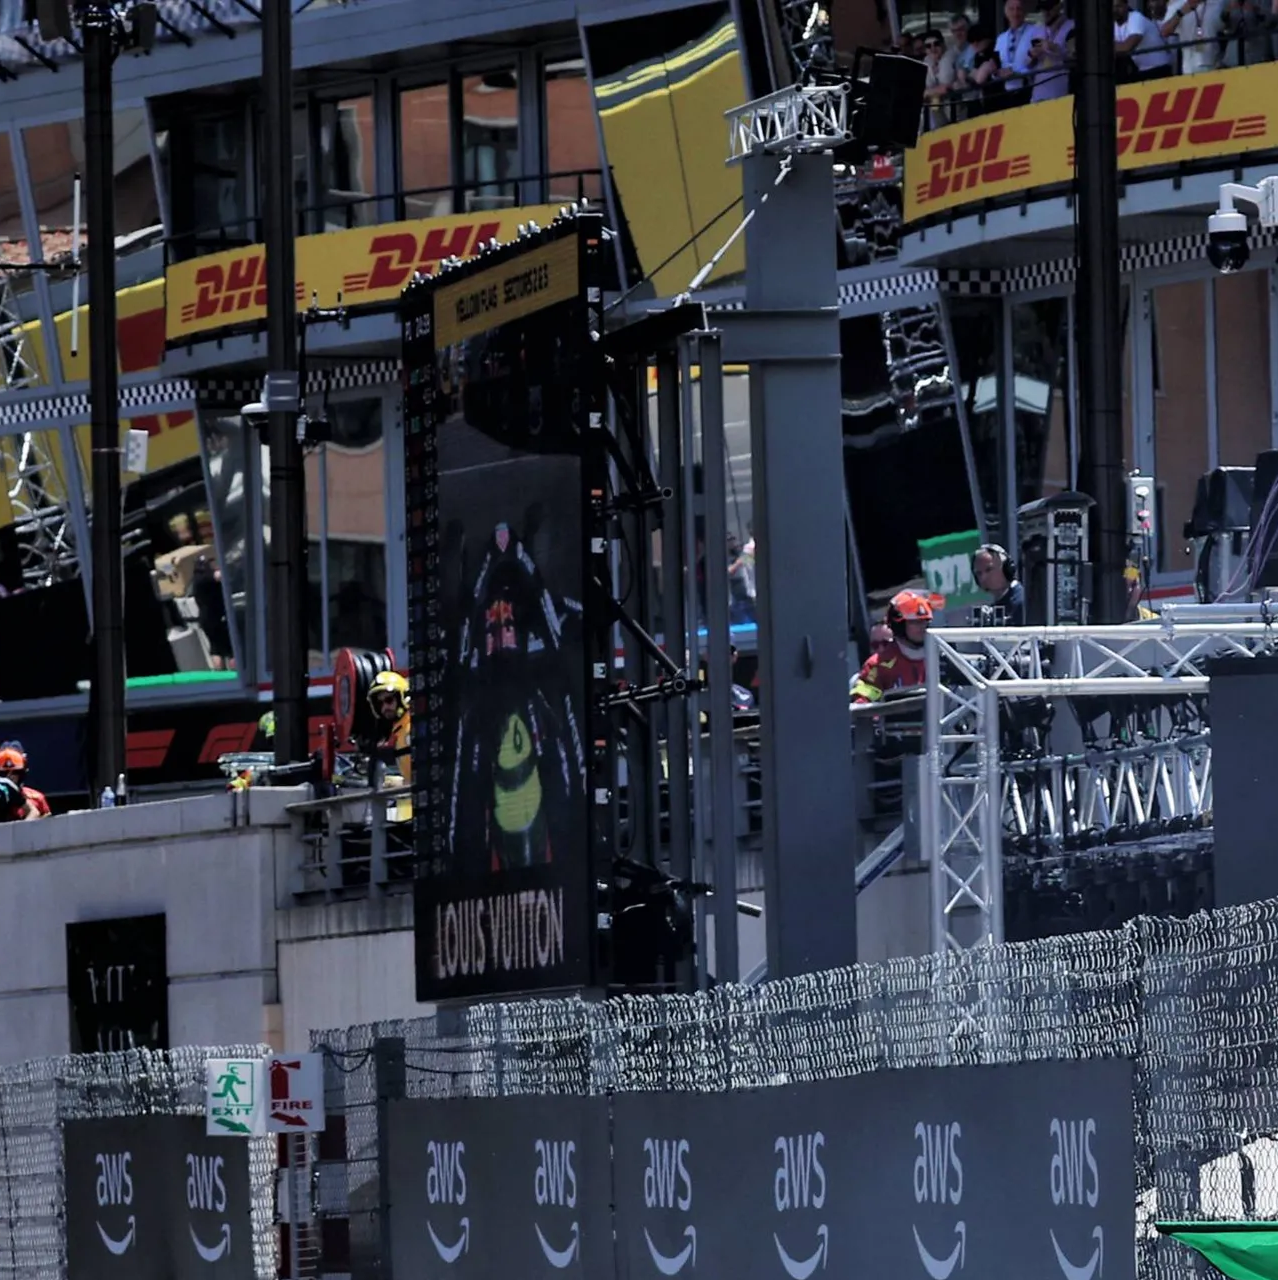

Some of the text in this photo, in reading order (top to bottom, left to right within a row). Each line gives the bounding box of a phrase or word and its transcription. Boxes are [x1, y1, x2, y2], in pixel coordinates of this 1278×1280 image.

[926, 124, 1011, 200] DHL
[435, 886, 565, 981] LOUIS VUITTON
[211, 1107, 253, 1116] EXIT
[271, 1101, 313, 1110] FIRE
[95, 1151, 134, 1207] aws
[186, 1153, 227, 1213] aws
[426, 1140, 467, 1206] aws
[534, 1139, 577, 1209] aws
[643, 1137, 692, 1212] aws
[774, 1131, 827, 1212] aws
[913, 1121, 963, 1206] aws
[1049, 1117, 1099, 1208] aws
